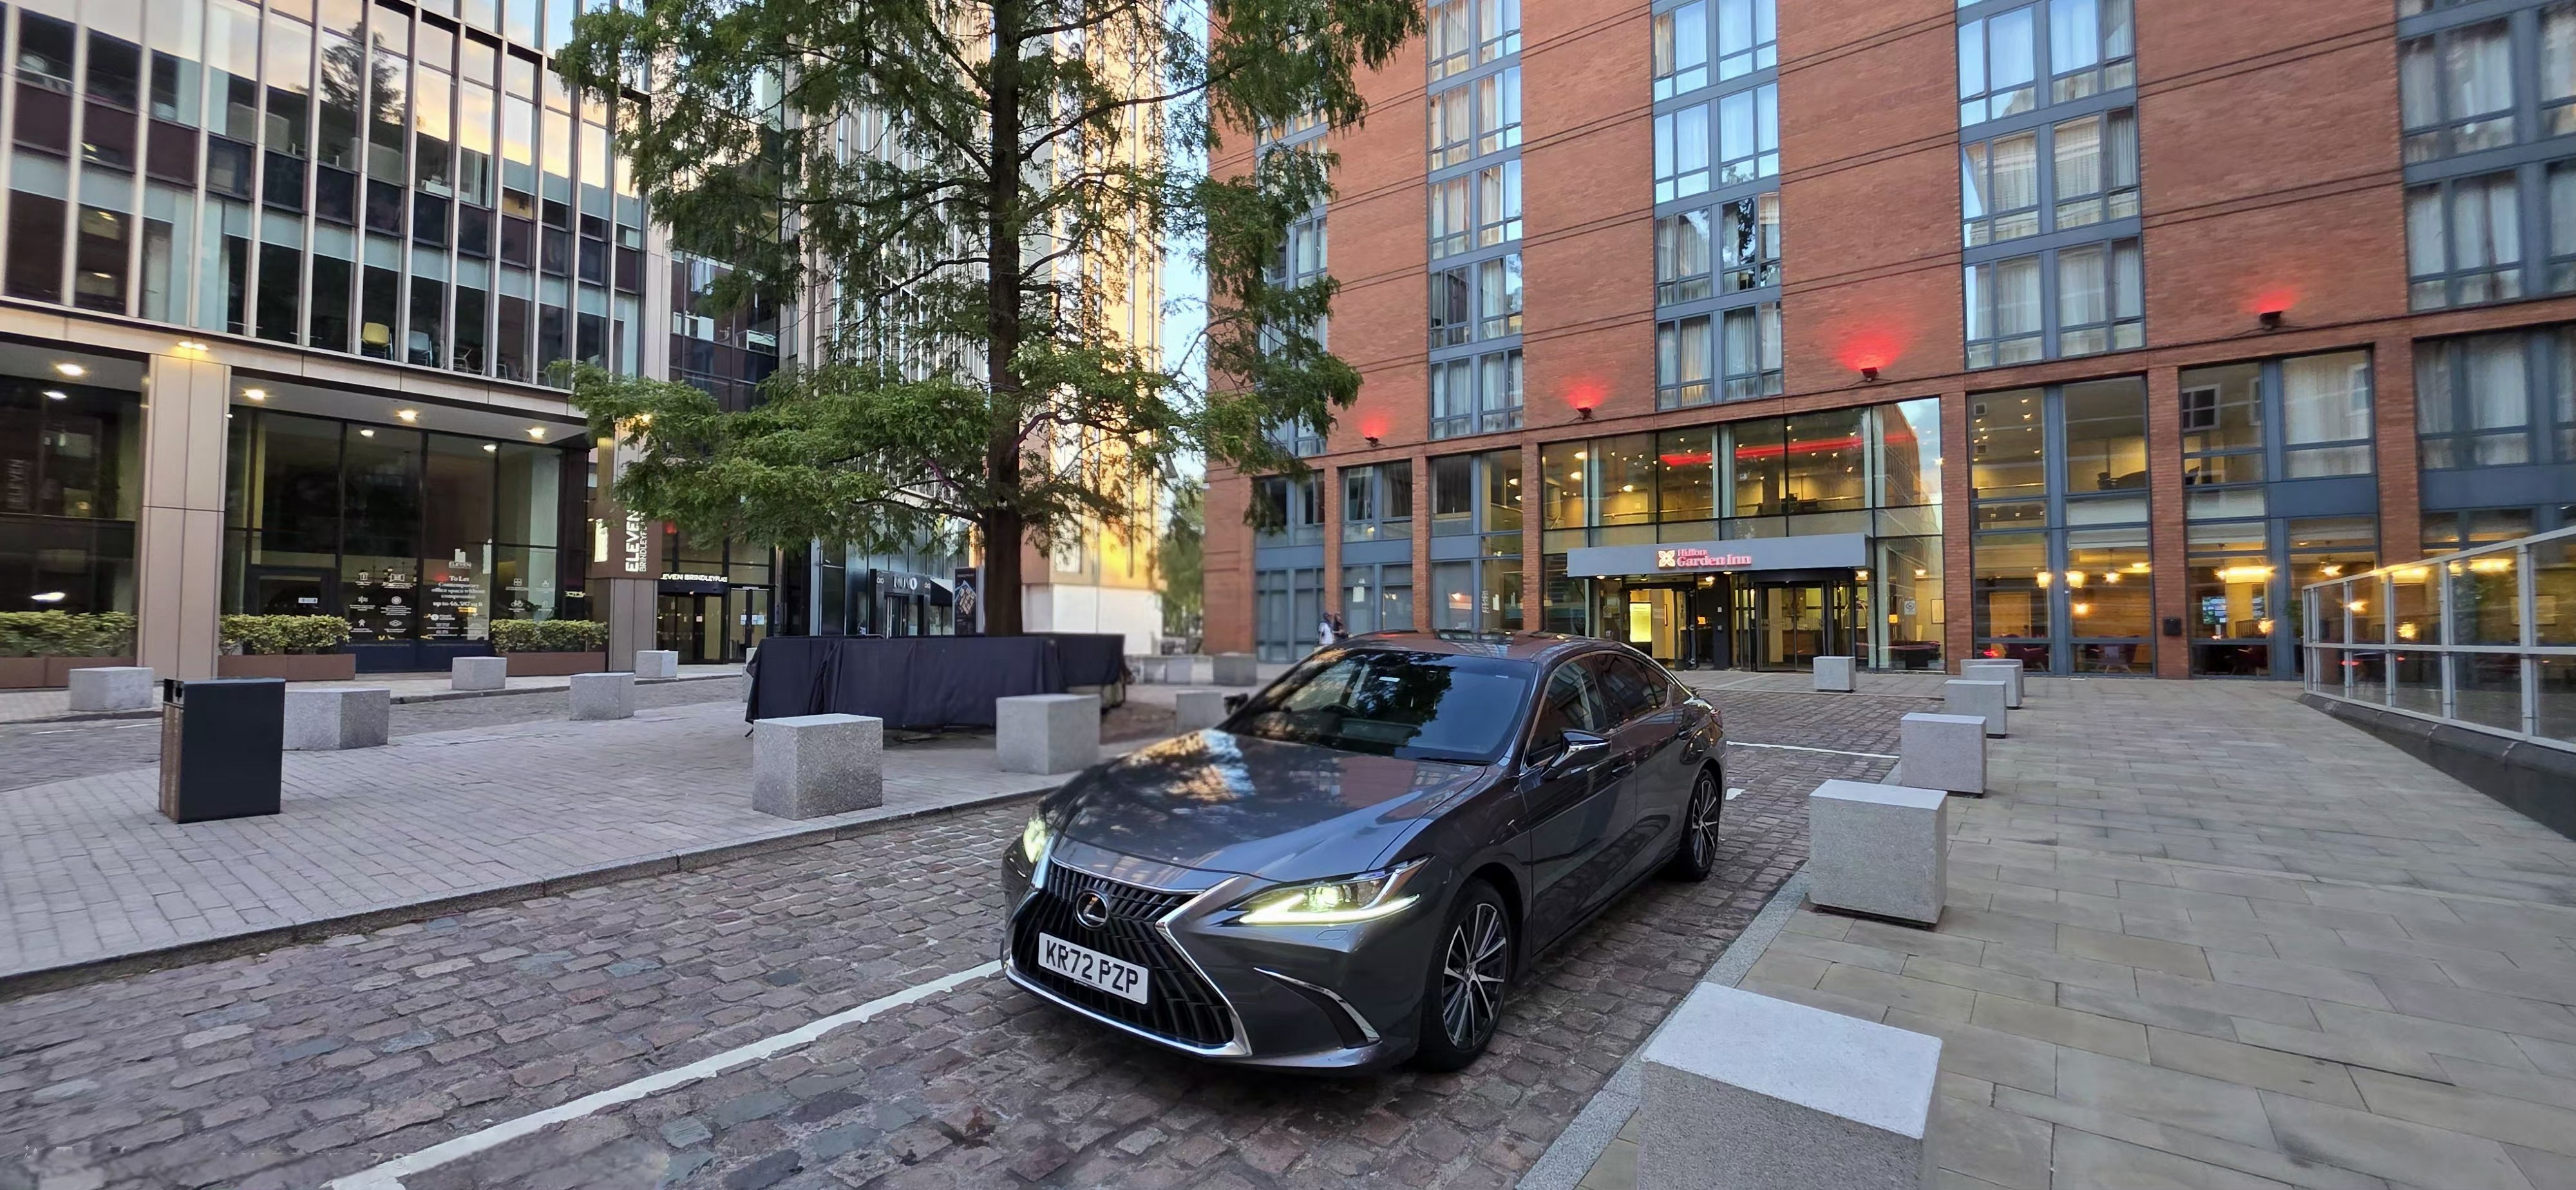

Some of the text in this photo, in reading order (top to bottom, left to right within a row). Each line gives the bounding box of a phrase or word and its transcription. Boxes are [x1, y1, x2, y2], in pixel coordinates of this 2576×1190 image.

[625, 509, 640, 572] ELEVEN
[1677, 549, 1708, 557] Hilton
[1676, 554, 1752, 567] Garden Inn
[1046, 940, 1139, 994] KR72 PZP
